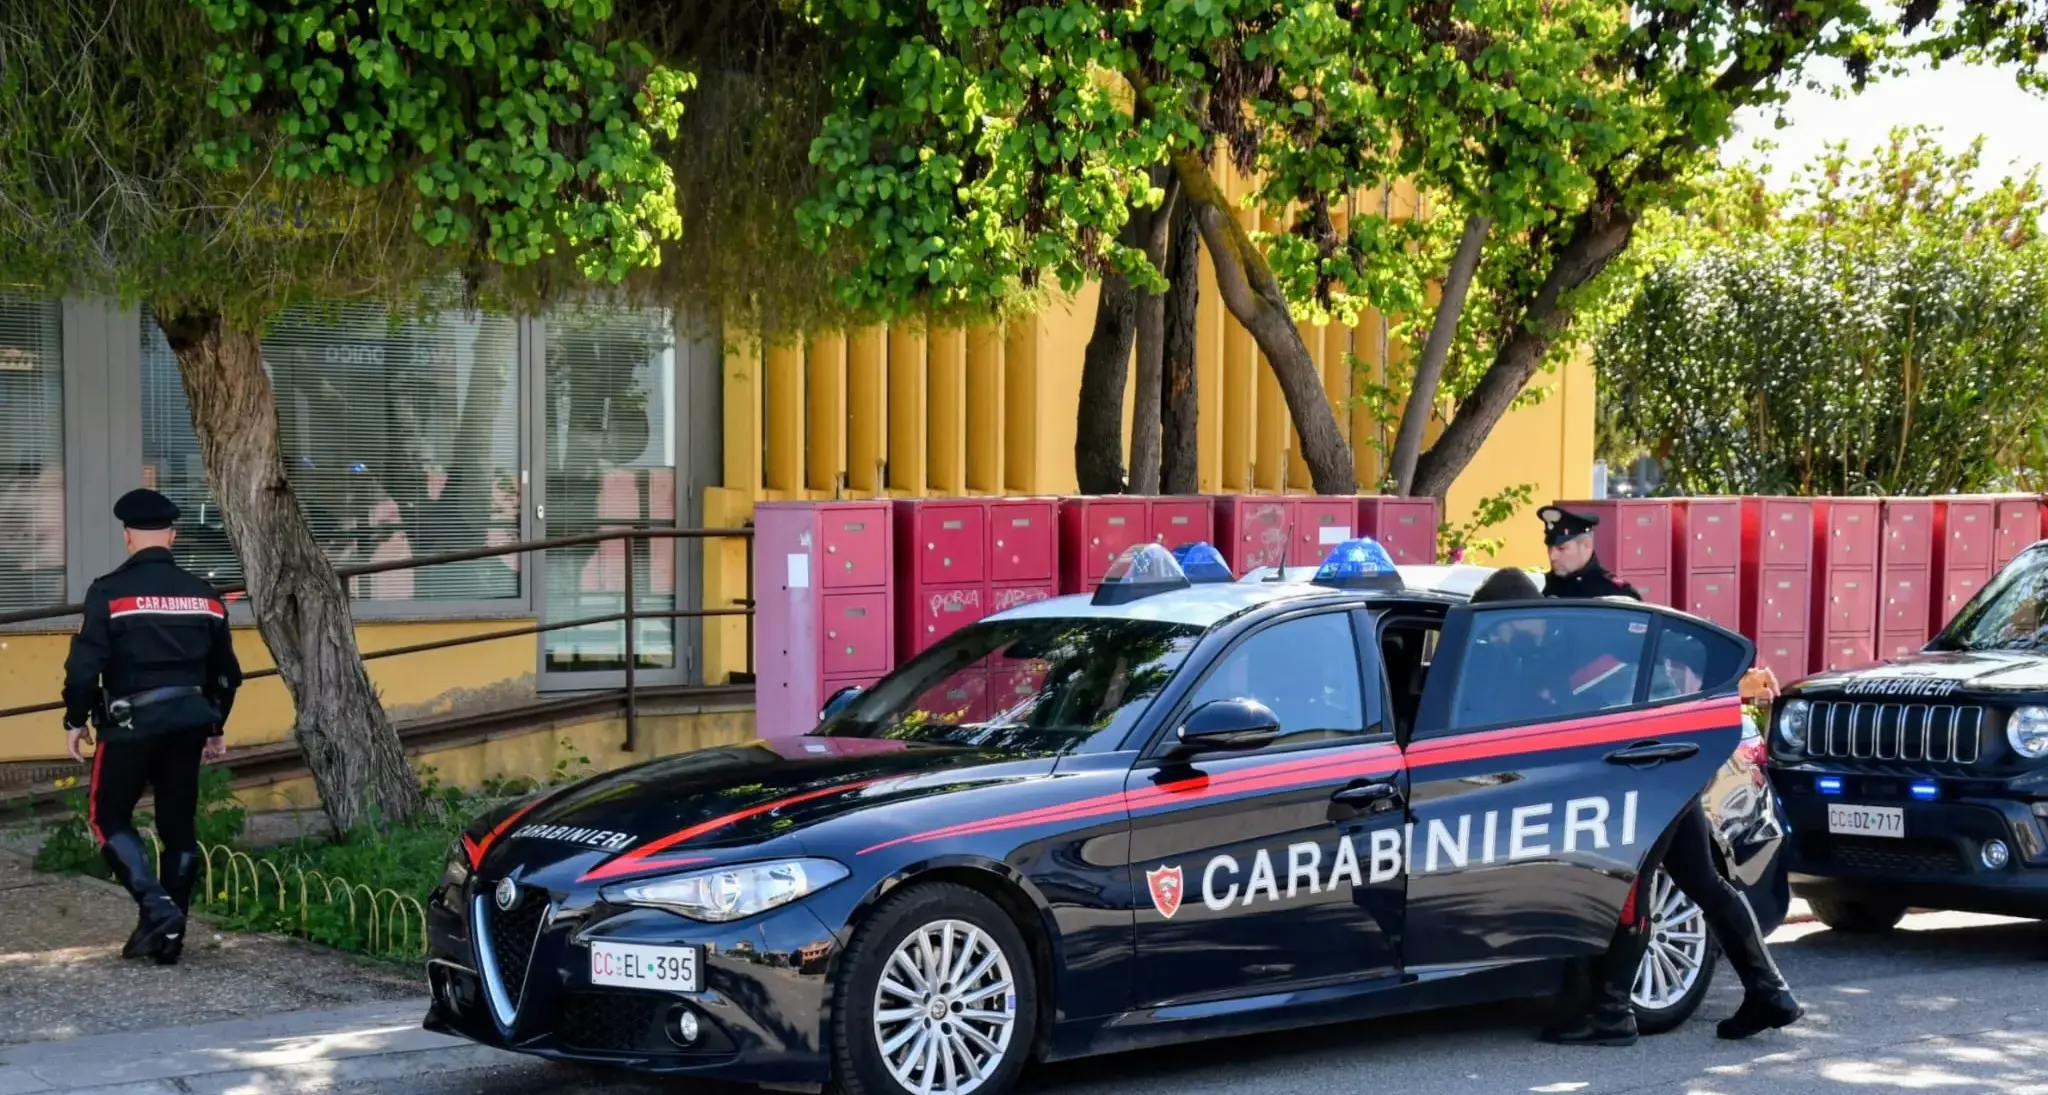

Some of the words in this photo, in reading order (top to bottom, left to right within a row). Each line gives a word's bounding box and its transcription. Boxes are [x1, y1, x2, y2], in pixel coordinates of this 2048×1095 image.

[135, 596, 209, 611] CARABINIERI
[1844, 678, 1960, 697] CARABINIERI
[1876, 813, 1902, 831] 717
[511, 823, 638, 850] CARABINIERI
[1201, 791, 1638, 912] CARABINIERI
[593, 951, 613, 975] CC
[624, 953, 645, 979] EL
[656, 956, 692, 981] 395
